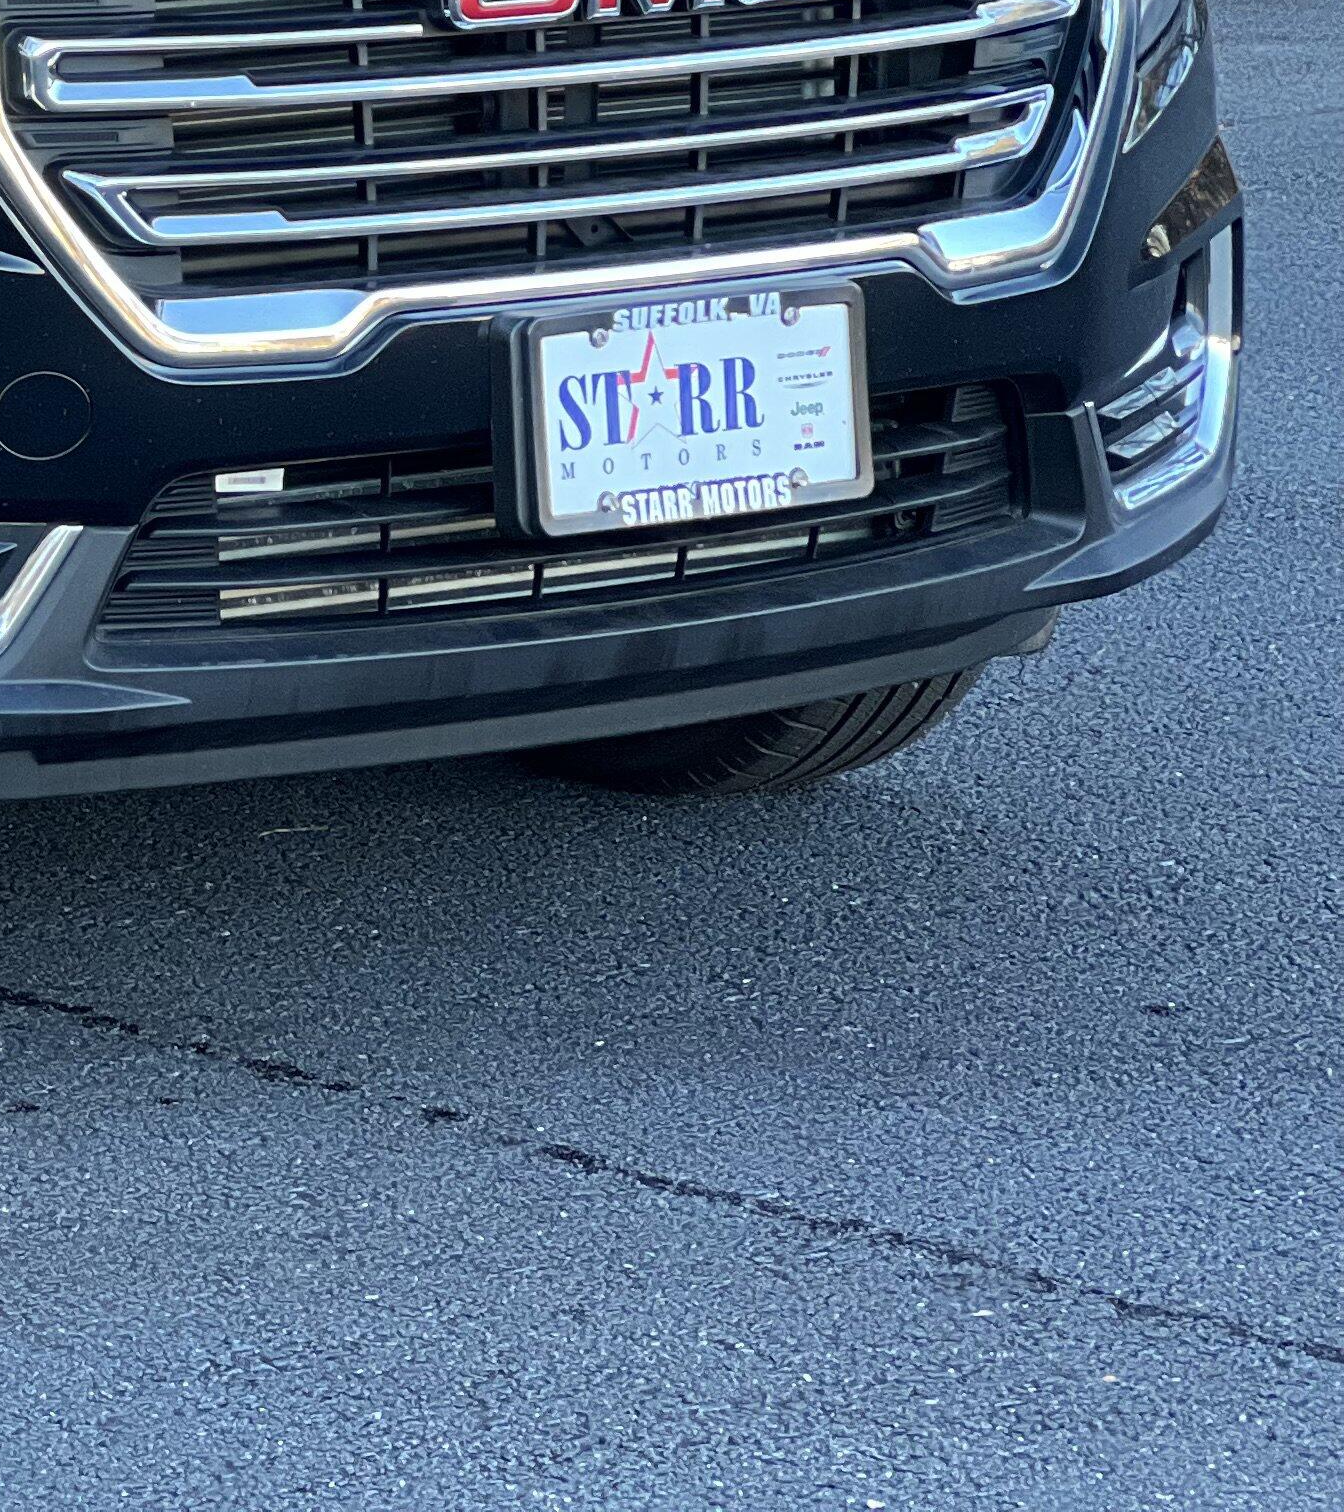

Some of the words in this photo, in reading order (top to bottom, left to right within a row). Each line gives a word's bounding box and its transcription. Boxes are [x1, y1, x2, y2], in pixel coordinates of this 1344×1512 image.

[749, 292, 781, 317] VA
[778, 371, 833, 382] CHRYSLER
[790, 401, 824, 416] Jeep
[561, 439, 762, 480] MOTORS
[621, 487, 694, 526] STARR
[701, 474, 792, 515] MOTORS
